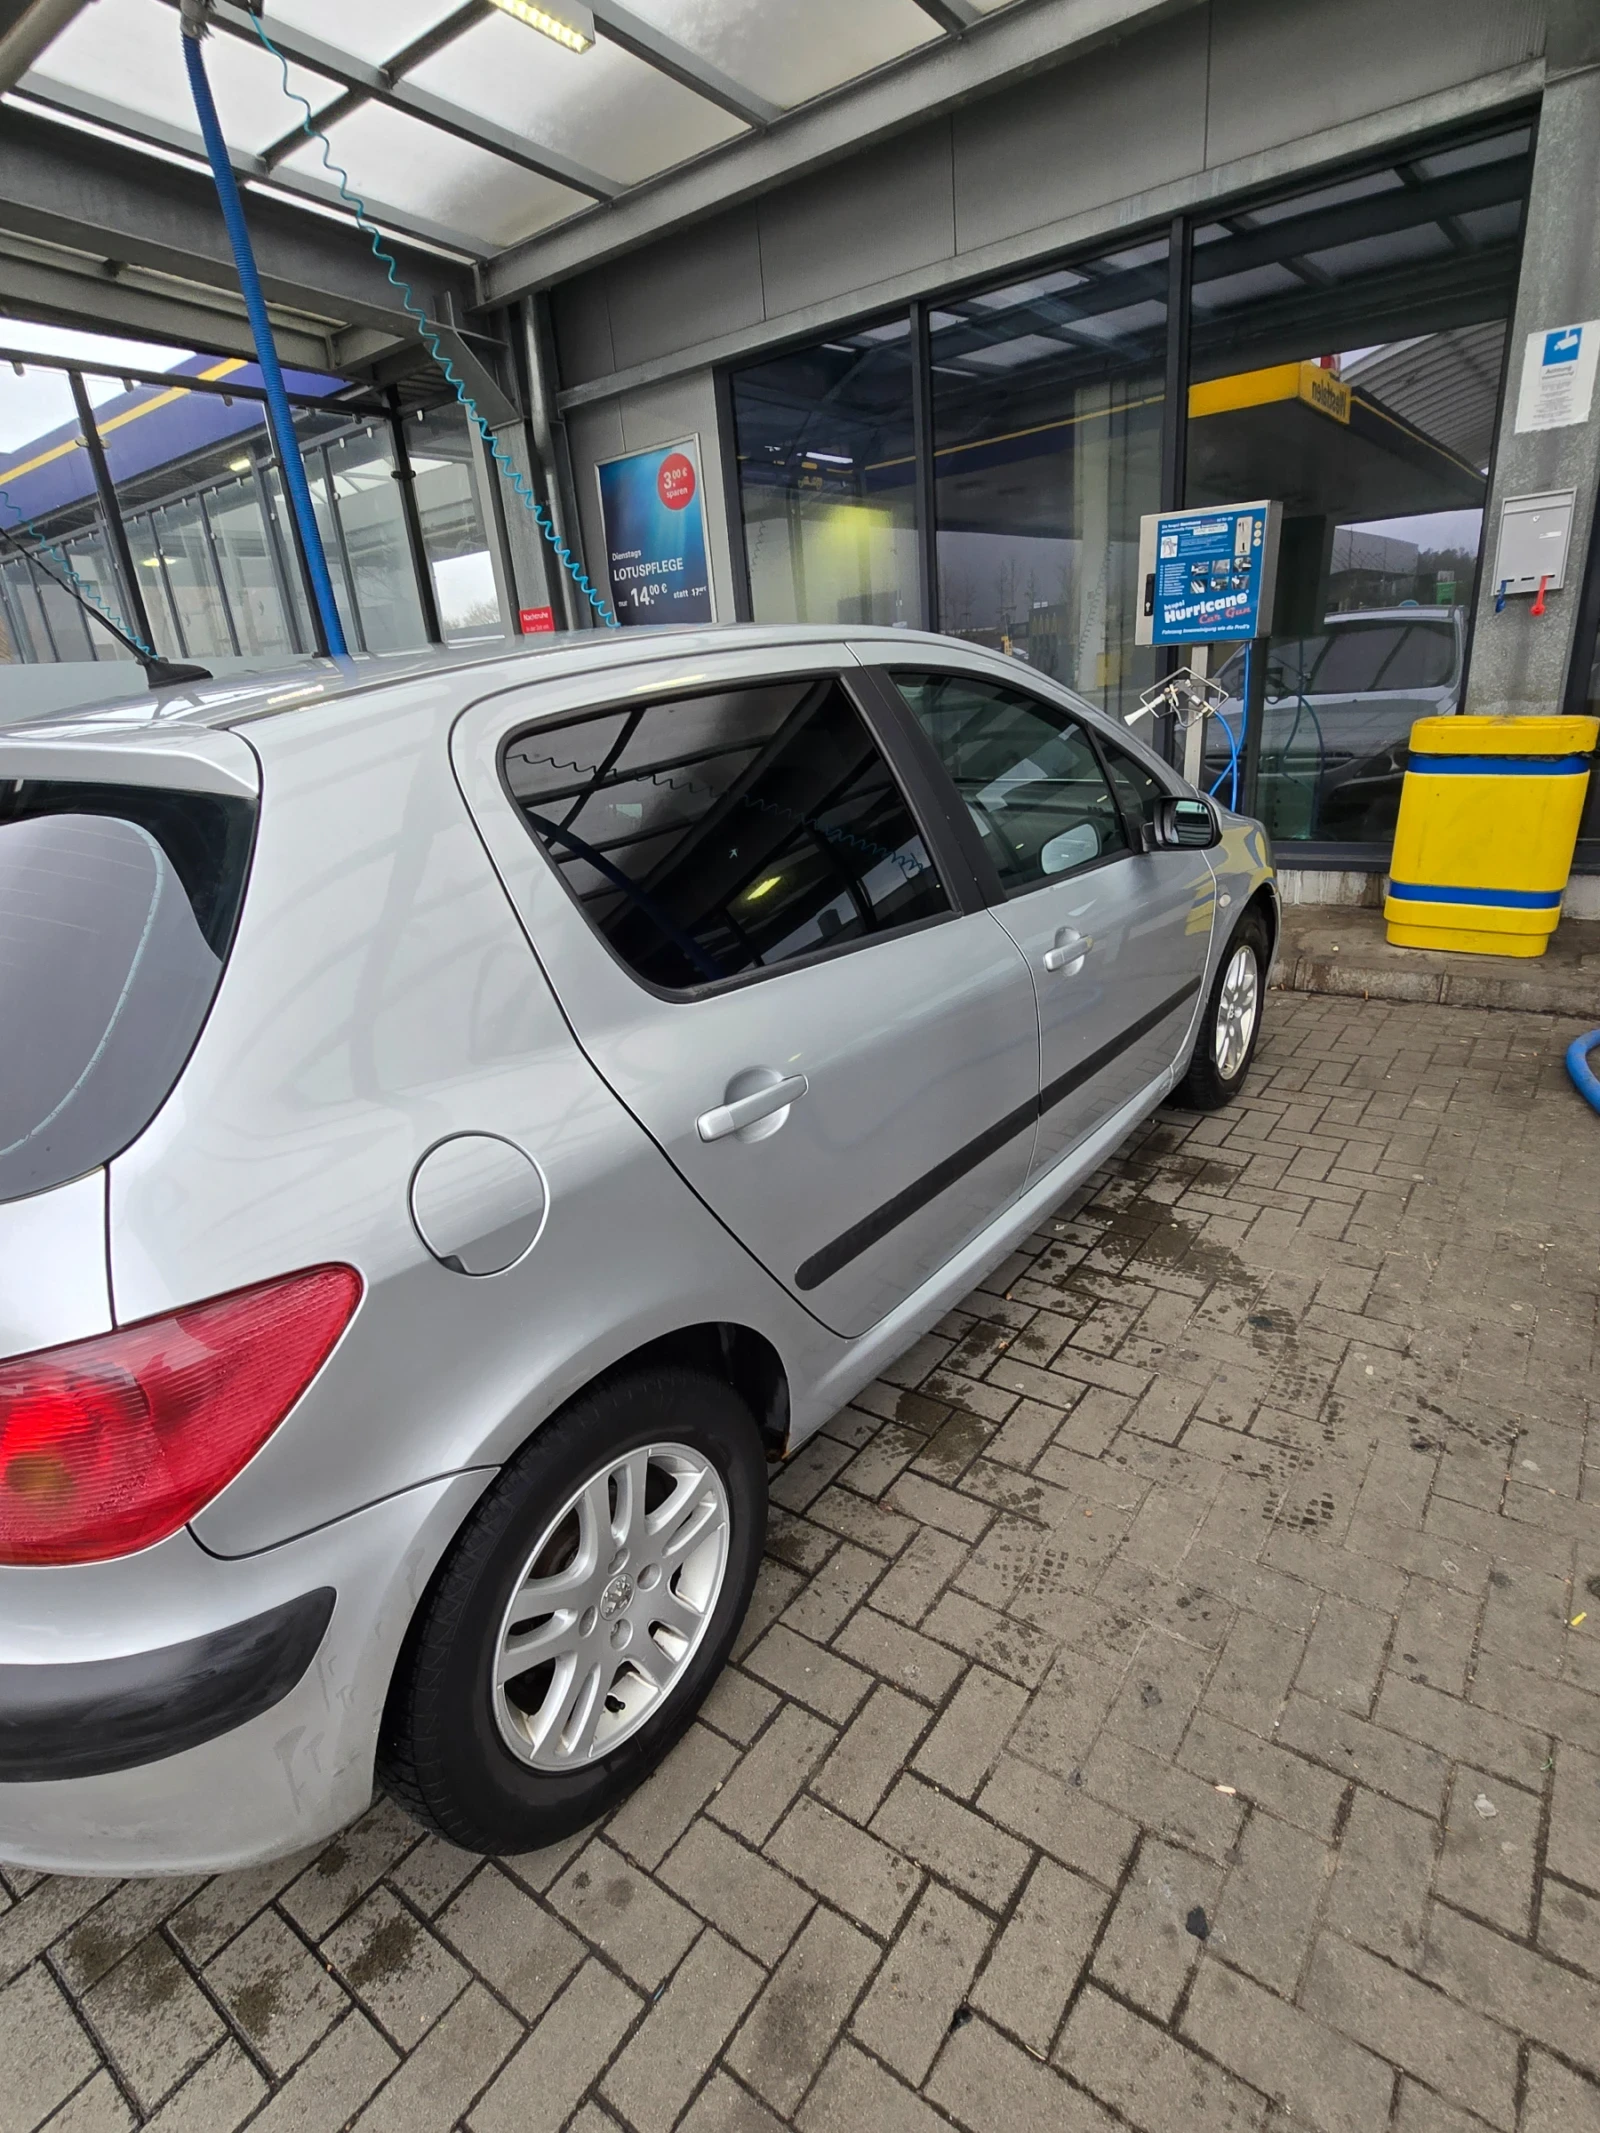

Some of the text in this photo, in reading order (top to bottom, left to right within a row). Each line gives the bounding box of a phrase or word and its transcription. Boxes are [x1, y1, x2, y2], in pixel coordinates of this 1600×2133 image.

[666, 486, 688, 499] sparen
[612, 550, 642, 562] Dienstags
[613, 557, 684, 582] LOTUSPFLEGE
[661, 583, 668, 594] €
[673, 589, 689, 599] statt
[1164, 592, 1248, 624] Hurricane
[1199, 607, 1251, 625] Car Gun
